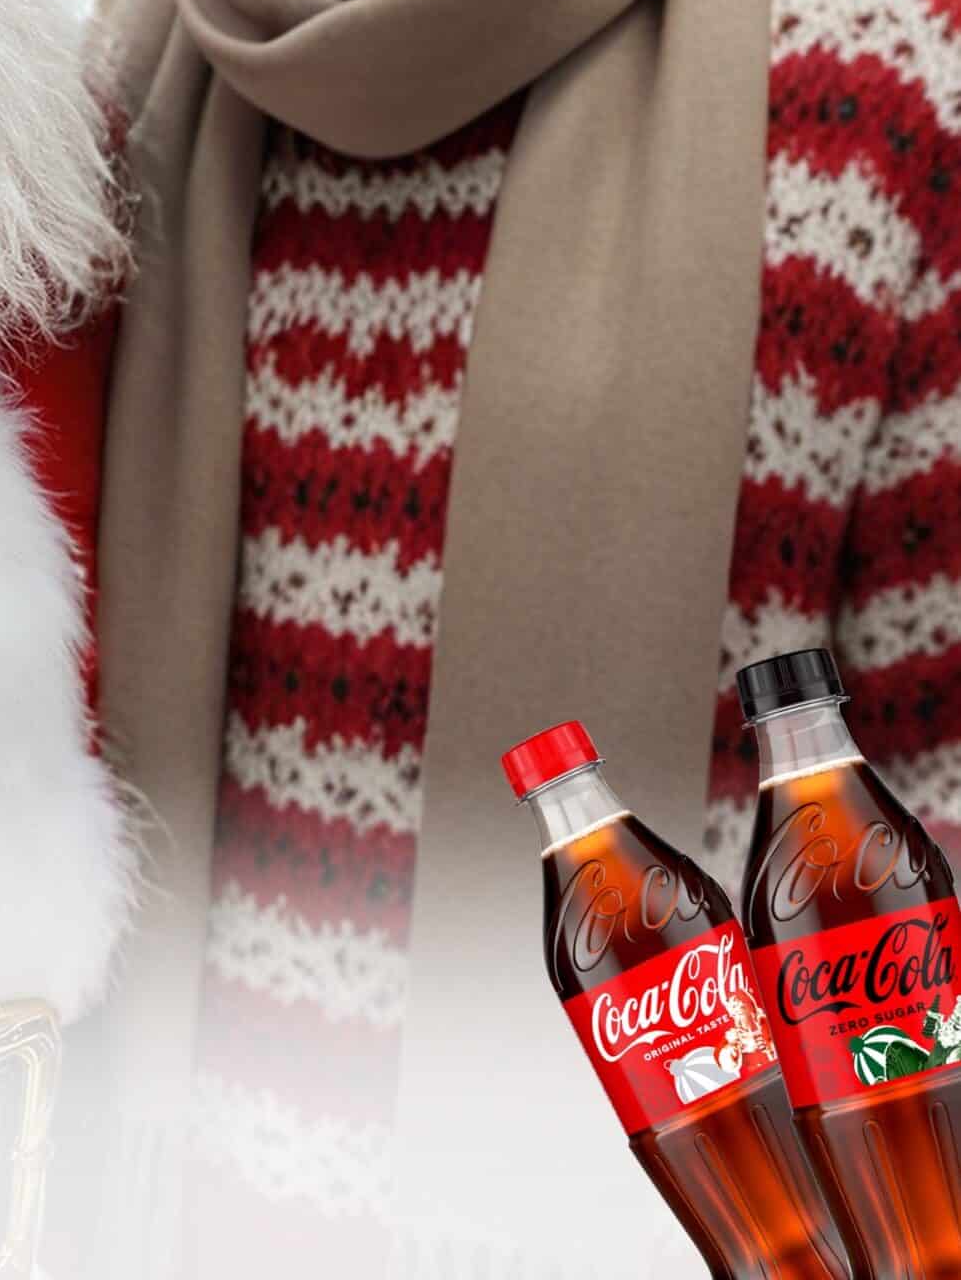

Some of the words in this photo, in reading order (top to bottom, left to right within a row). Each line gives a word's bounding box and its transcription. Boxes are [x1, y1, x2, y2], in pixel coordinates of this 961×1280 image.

[777, 912, 955, 1026] Coca-Cola
[643, 1033, 695, 1061] ORIGINAL
[696, 1014, 730, 1034] TASTE
[829, 1017, 869, 1036] ZERO
[874, 1001, 926, 1025] SUGAR
